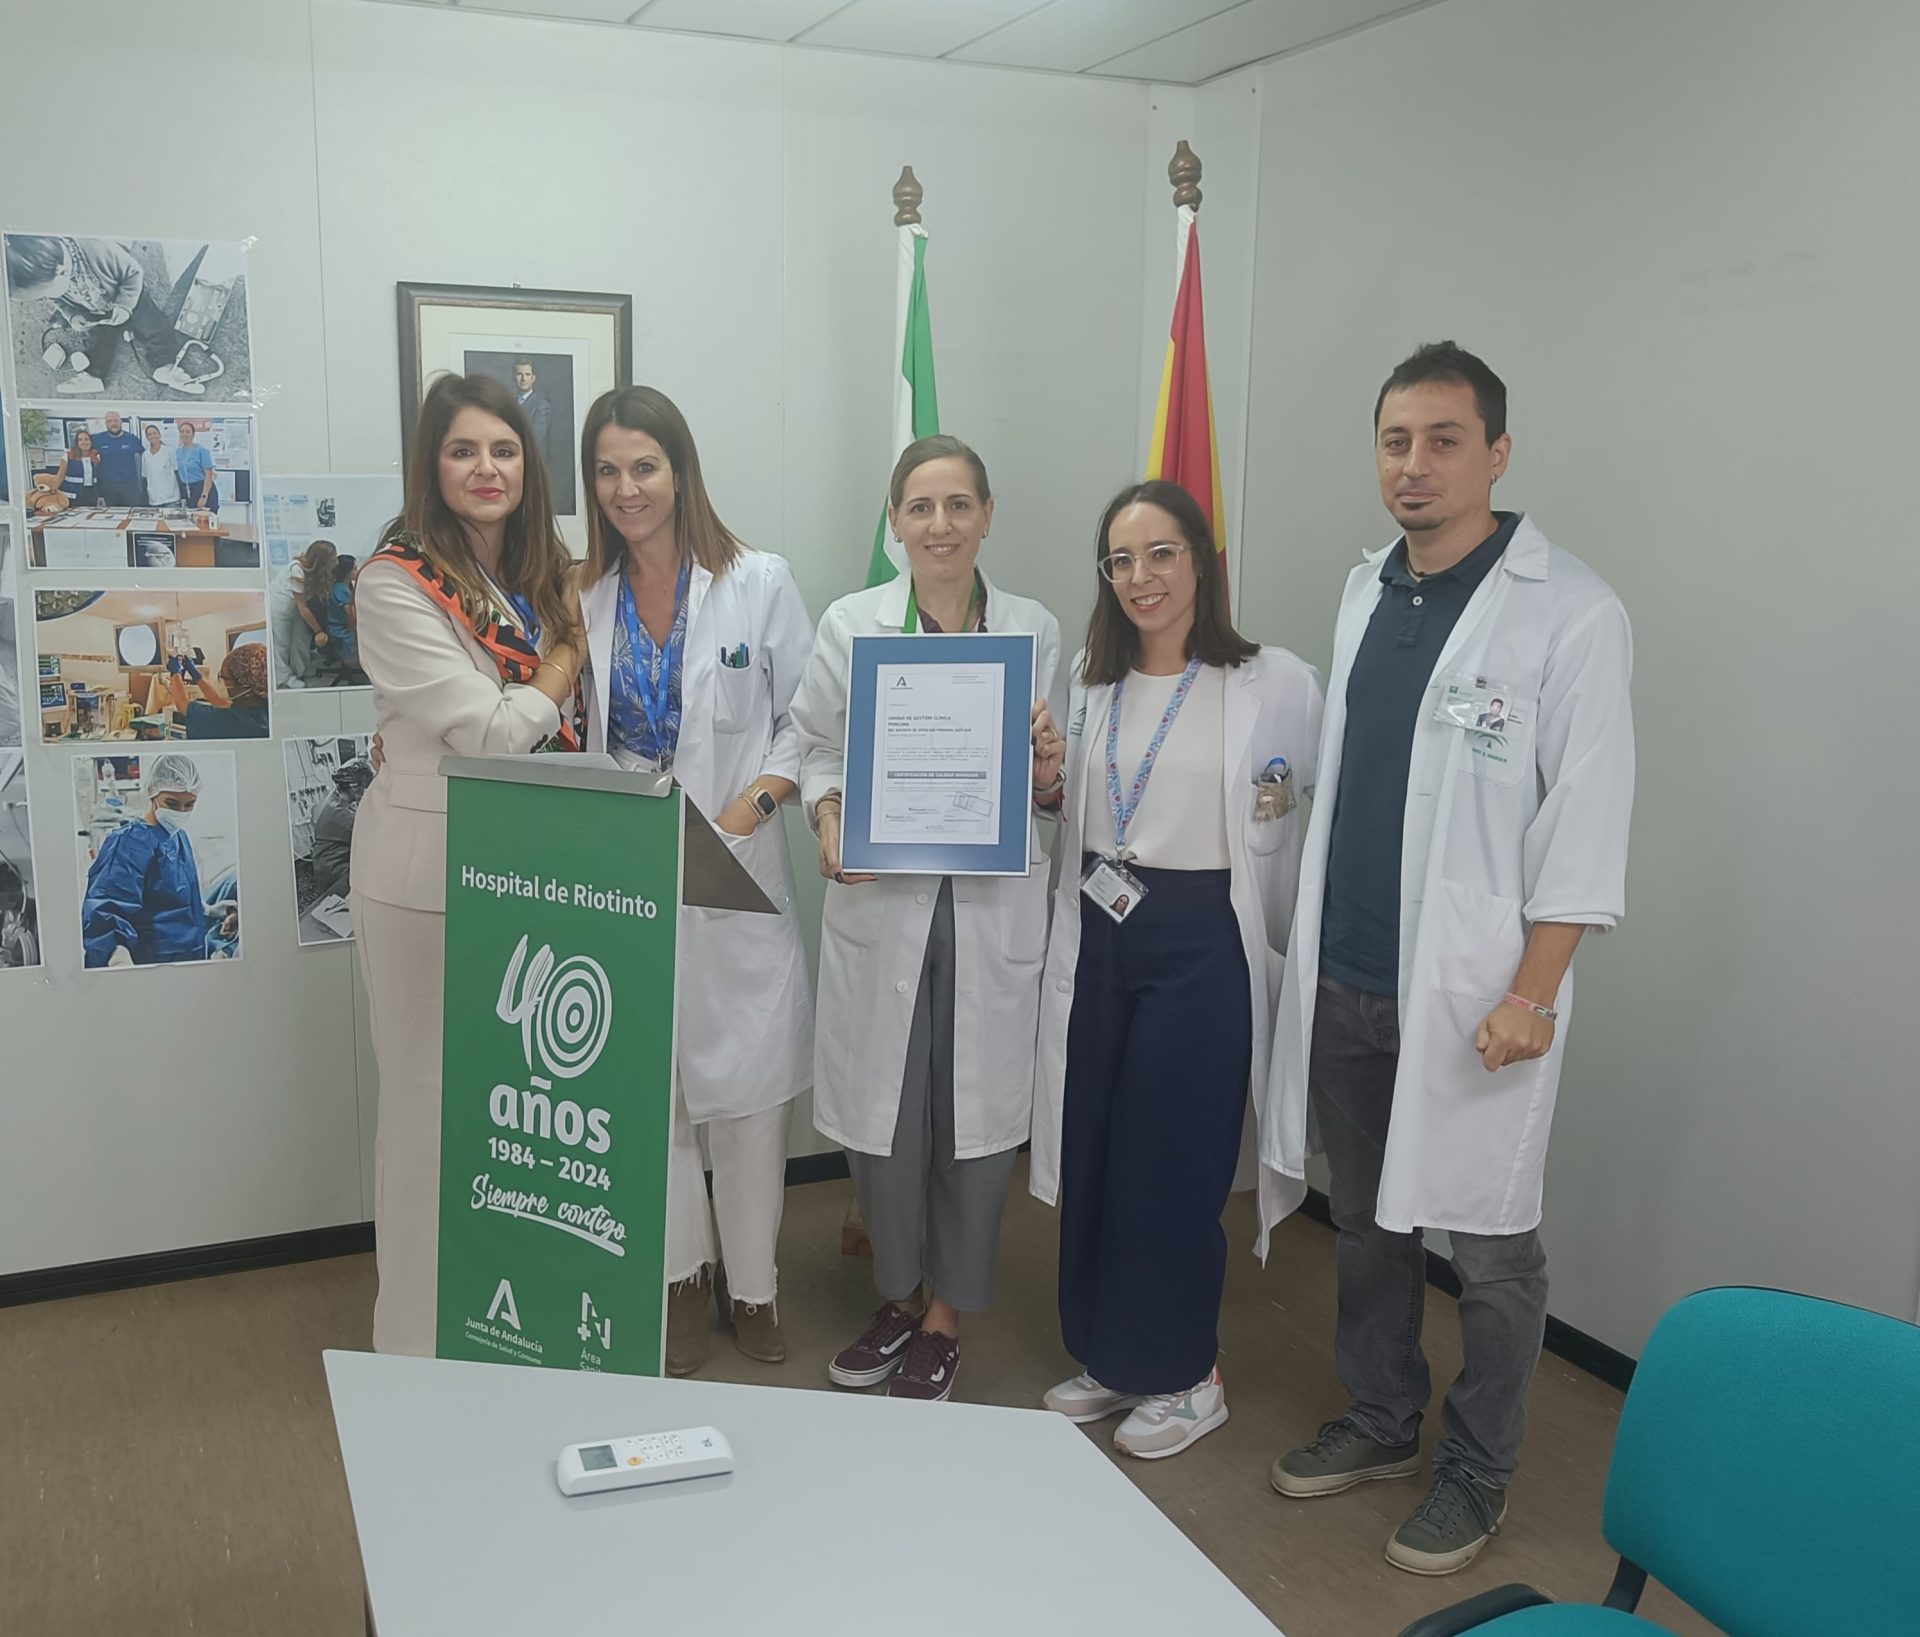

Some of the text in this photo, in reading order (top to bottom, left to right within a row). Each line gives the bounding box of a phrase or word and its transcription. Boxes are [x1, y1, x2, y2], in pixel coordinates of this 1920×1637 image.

[461, 865, 657, 919] Hospital de Riotinto
[496, 933, 612, 1078] 40
[489, 1075, 611, 1154] años
[488, 1137, 535, 1169] 1984
[558, 1156, 611, 1191] 2024
[471, 1173, 627, 1241] Siempre contigo
[465, 1317, 543, 1353] Junta de Andalucía
[581, 1347, 601, 1365] Área
